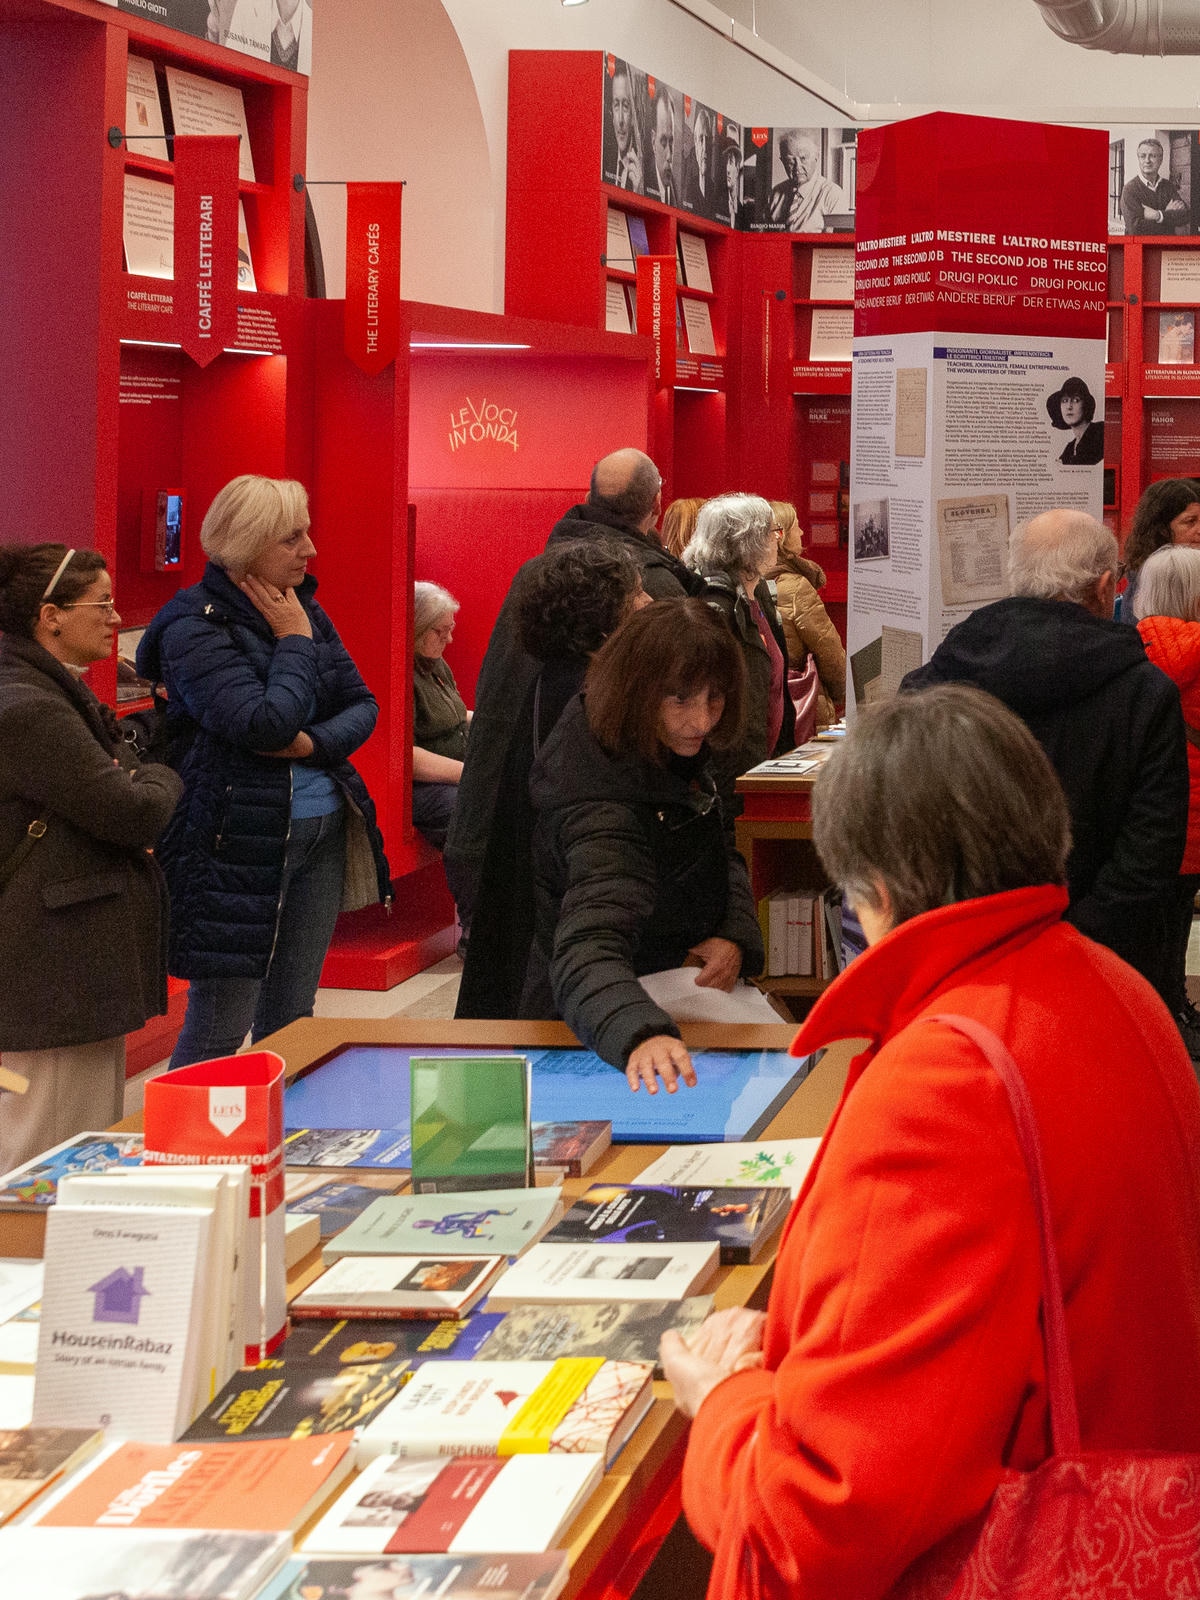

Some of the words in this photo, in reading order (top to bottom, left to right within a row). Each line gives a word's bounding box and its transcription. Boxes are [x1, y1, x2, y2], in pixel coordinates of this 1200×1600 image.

[148, 2, 167, 17] GIOTTI
[224, 30, 249, 45] SUSANNA
[249, 39, 270, 53] TAMARO
[200, 196, 213, 277] LETTERARI
[857, 239, 879, 253] L'ALTRO
[879, 235, 907, 249] MESTIERE
[911, 231, 934, 244] L'ALTRO
[937, 230, 996, 245] MESTIERE
[1003, 235, 1048, 249] L'ALTRO
[1050, 239, 1107, 254] MESTIERE
[856, 260, 877, 272] SECOND
[878, 258, 889, 269] JOB
[892, 255, 903, 266] THE
[904, 252, 927, 265] SECOND
[951, 251, 974, 263] THE
[976, 253, 1024, 267] SECOND
[1026, 257, 1048, 269] JOB
[1053, 259, 1074, 271] THE
[1077, 261, 1107, 273] SECO
[653, 262, 661, 301] CONSOLI
[856, 279, 872, 291] DRUGI
[872, 277, 891, 288] POKLIC
[894, 274, 911, 286] DRUGI
[911, 272, 931, 284] POKLIC
[939, 270, 975, 283] DRUGI
[978, 274, 1018, 287] POKLIC
[1030, 277, 1064, 289] DRUGI
[1067, 280, 1106, 292] POKLIC
[128, 303, 137, 311] THE
[138, 304, 160, 313] LITERARY
[368, 268, 379, 326] LITERARY
[866, 297, 886, 309] ANDERE
[886, 295, 902, 306] BERUF
[905, 293, 917, 305] DER
[917, 291, 935, 304] ETWAS
[937, 292, 980, 305] ANDERE
[983, 294, 1016, 306] BERUF
[1023, 296, 1044, 308] DER
[1046, 298, 1081, 310] ETWAS
[1083, 301, 1105, 312] AND
[367, 329, 378, 354] THE
[450, 408, 470, 429] LE
[466, 397, 518, 428] VOCI
[449, 427, 467, 452] IN
[470, 422, 519, 452] ONDA
[143, 1149, 201, 1165] CITAZIONI
[52, 1331, 173, 1355] HouseinRabaz
